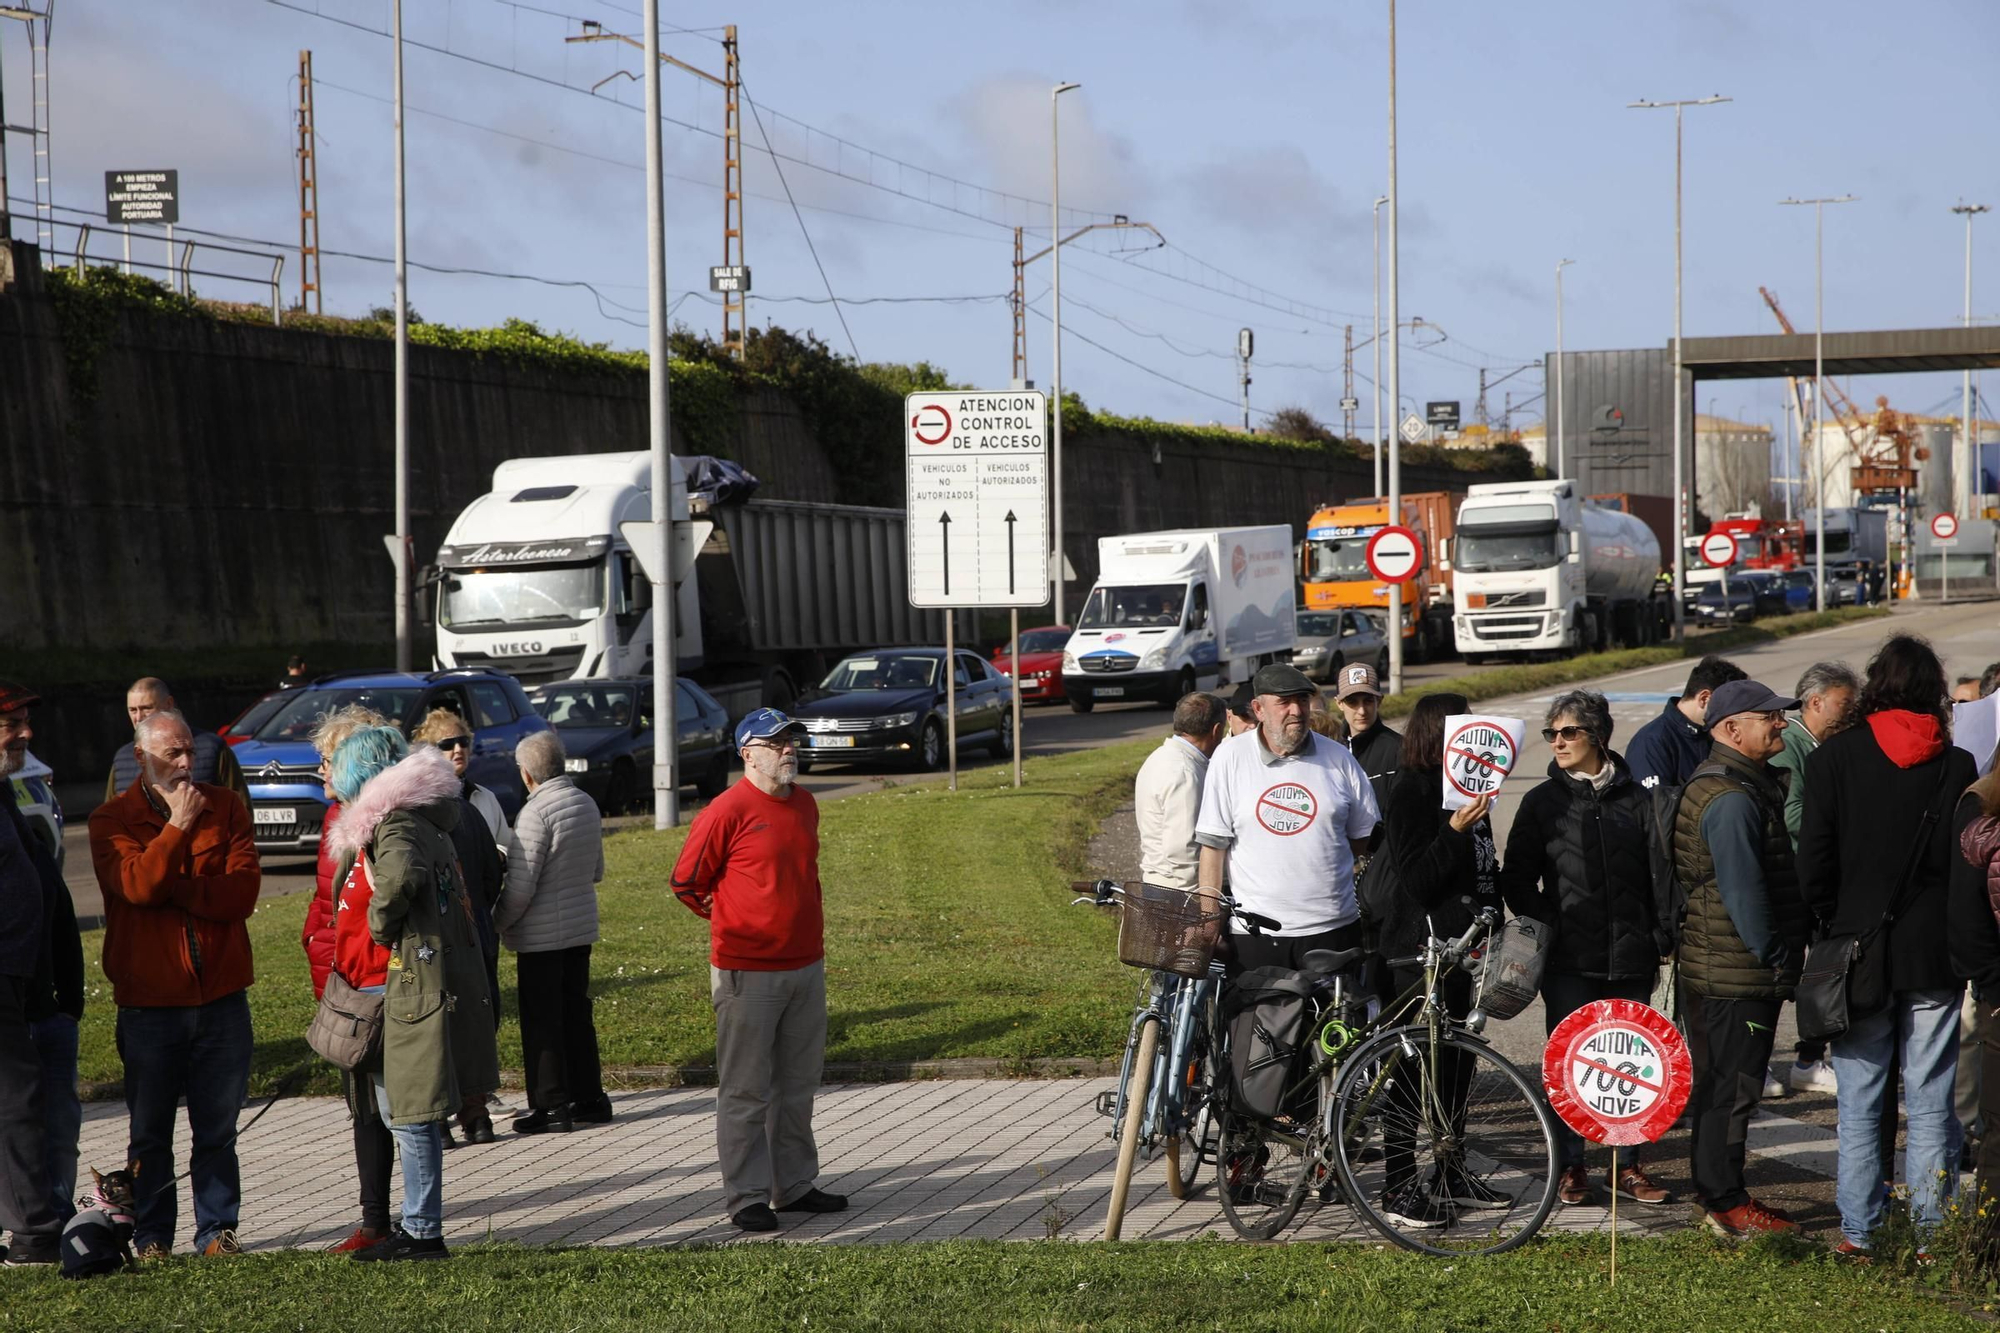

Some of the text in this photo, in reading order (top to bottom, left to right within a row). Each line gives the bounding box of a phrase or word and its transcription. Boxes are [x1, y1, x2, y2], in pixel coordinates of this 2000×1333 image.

[136, 173, 166, 182] METROS
[126, 183, 157, 191] EMPIEZA
[133, 191, 174, 201] FUNCIONAL
[121, 201, 163, 210] AUTORIDAD
[121, 210, 163, 219] PORTUARIA
[714, 267, 742, 277] SALE DE
[959, 398, 1035, 412] ATENCION
[961, 417, 1032, 430] CONTROL
[1407, 422, 1419, 432] 20
[953, 435, 1041, 449] DE ACCESO
[922, 464, 967, 473] VEHICULOS
[987, 463, 1030, 472] VEHICULOS
[939, 478, 951, 486] NO
[982, 476, 1037, 485] AUTORIZADOS
[917, 491, 974, 500] AUTORIZADOS
[492, 641, 543, 655] IVECO
[1458, 777, 1495, 792] JOVE
[273, 810, 293, 821] LVR
[1269, 821, 1300, 831] JOVE
[1589, 1096, 1640, 1115] JOVE
